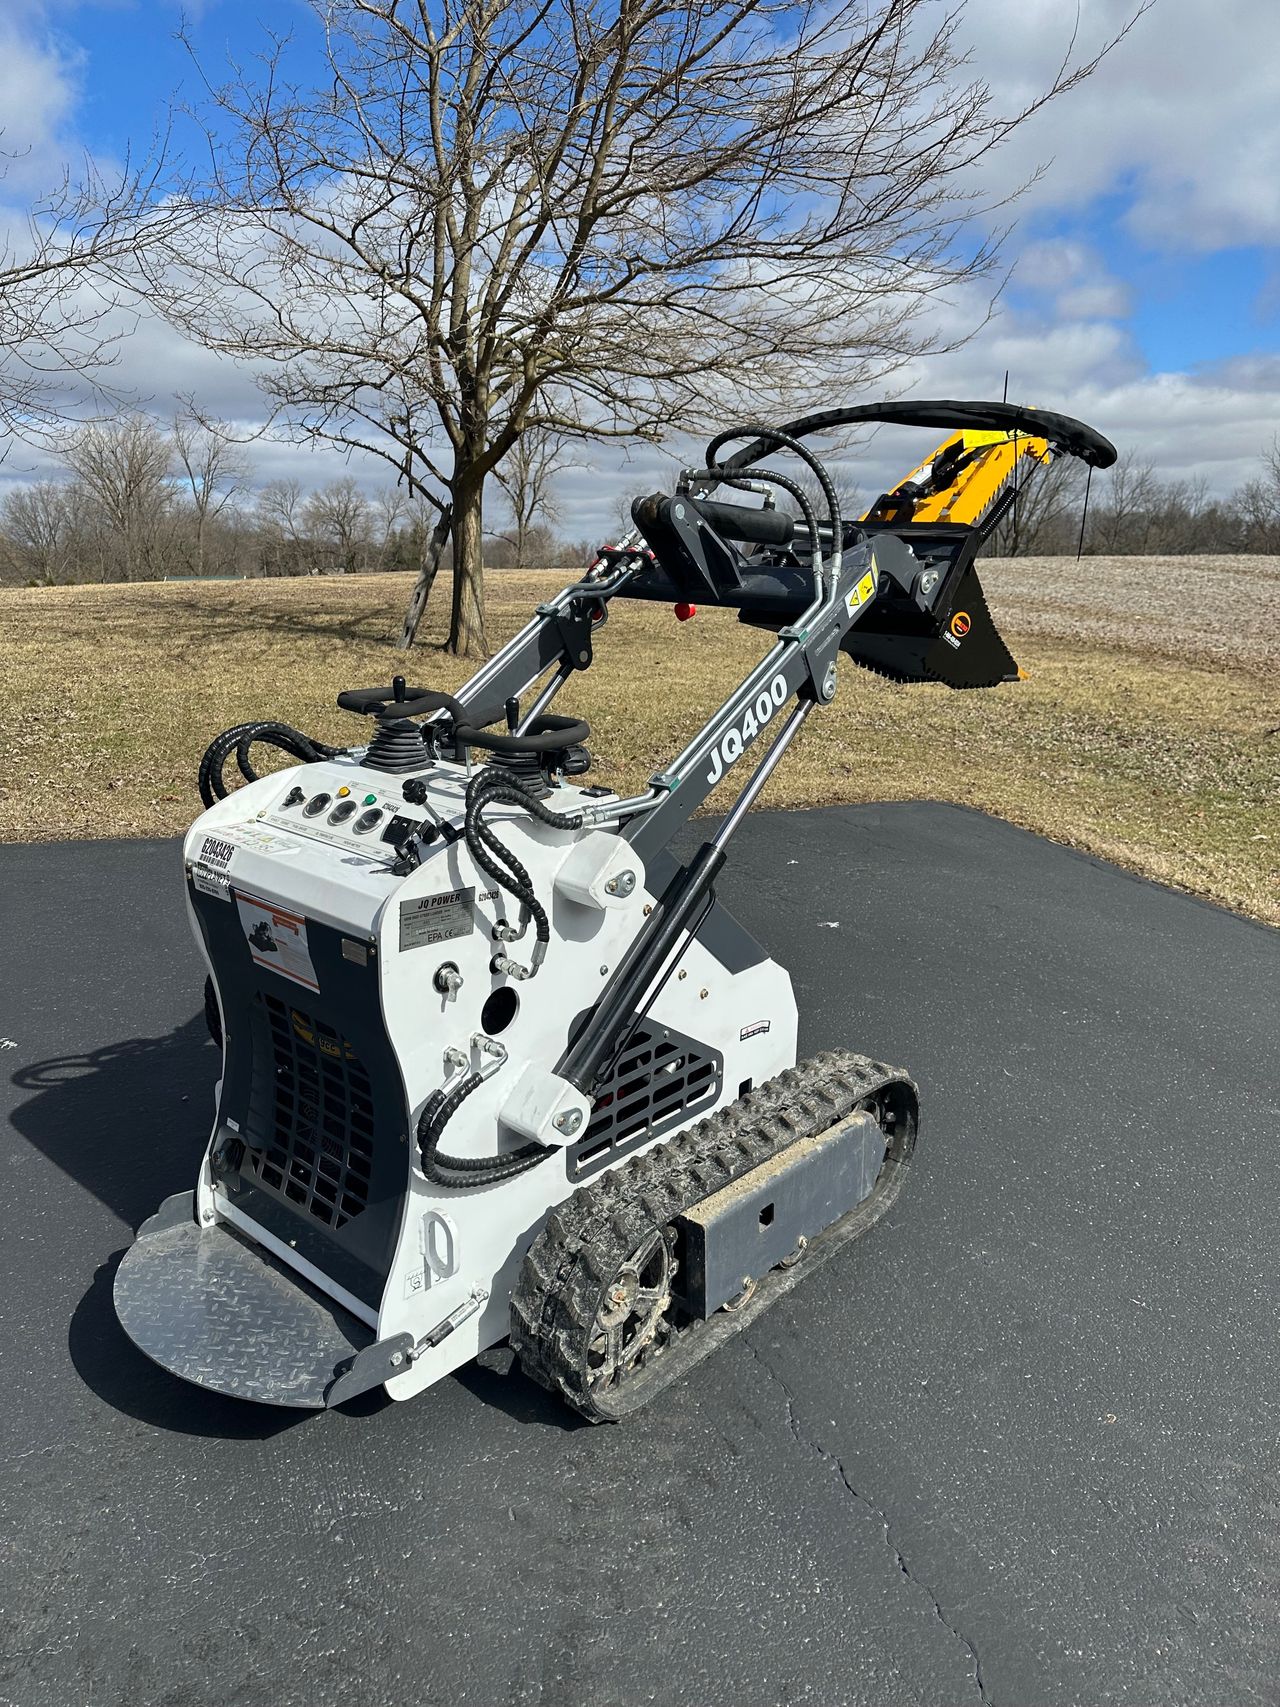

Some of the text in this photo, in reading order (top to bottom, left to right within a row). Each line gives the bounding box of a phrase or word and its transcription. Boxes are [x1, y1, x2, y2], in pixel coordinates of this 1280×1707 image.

[707, 674, 787, 784] JQ400
[418, 893, 460, 910] JQ POWER
[427, 931, 443, 943] EPA
